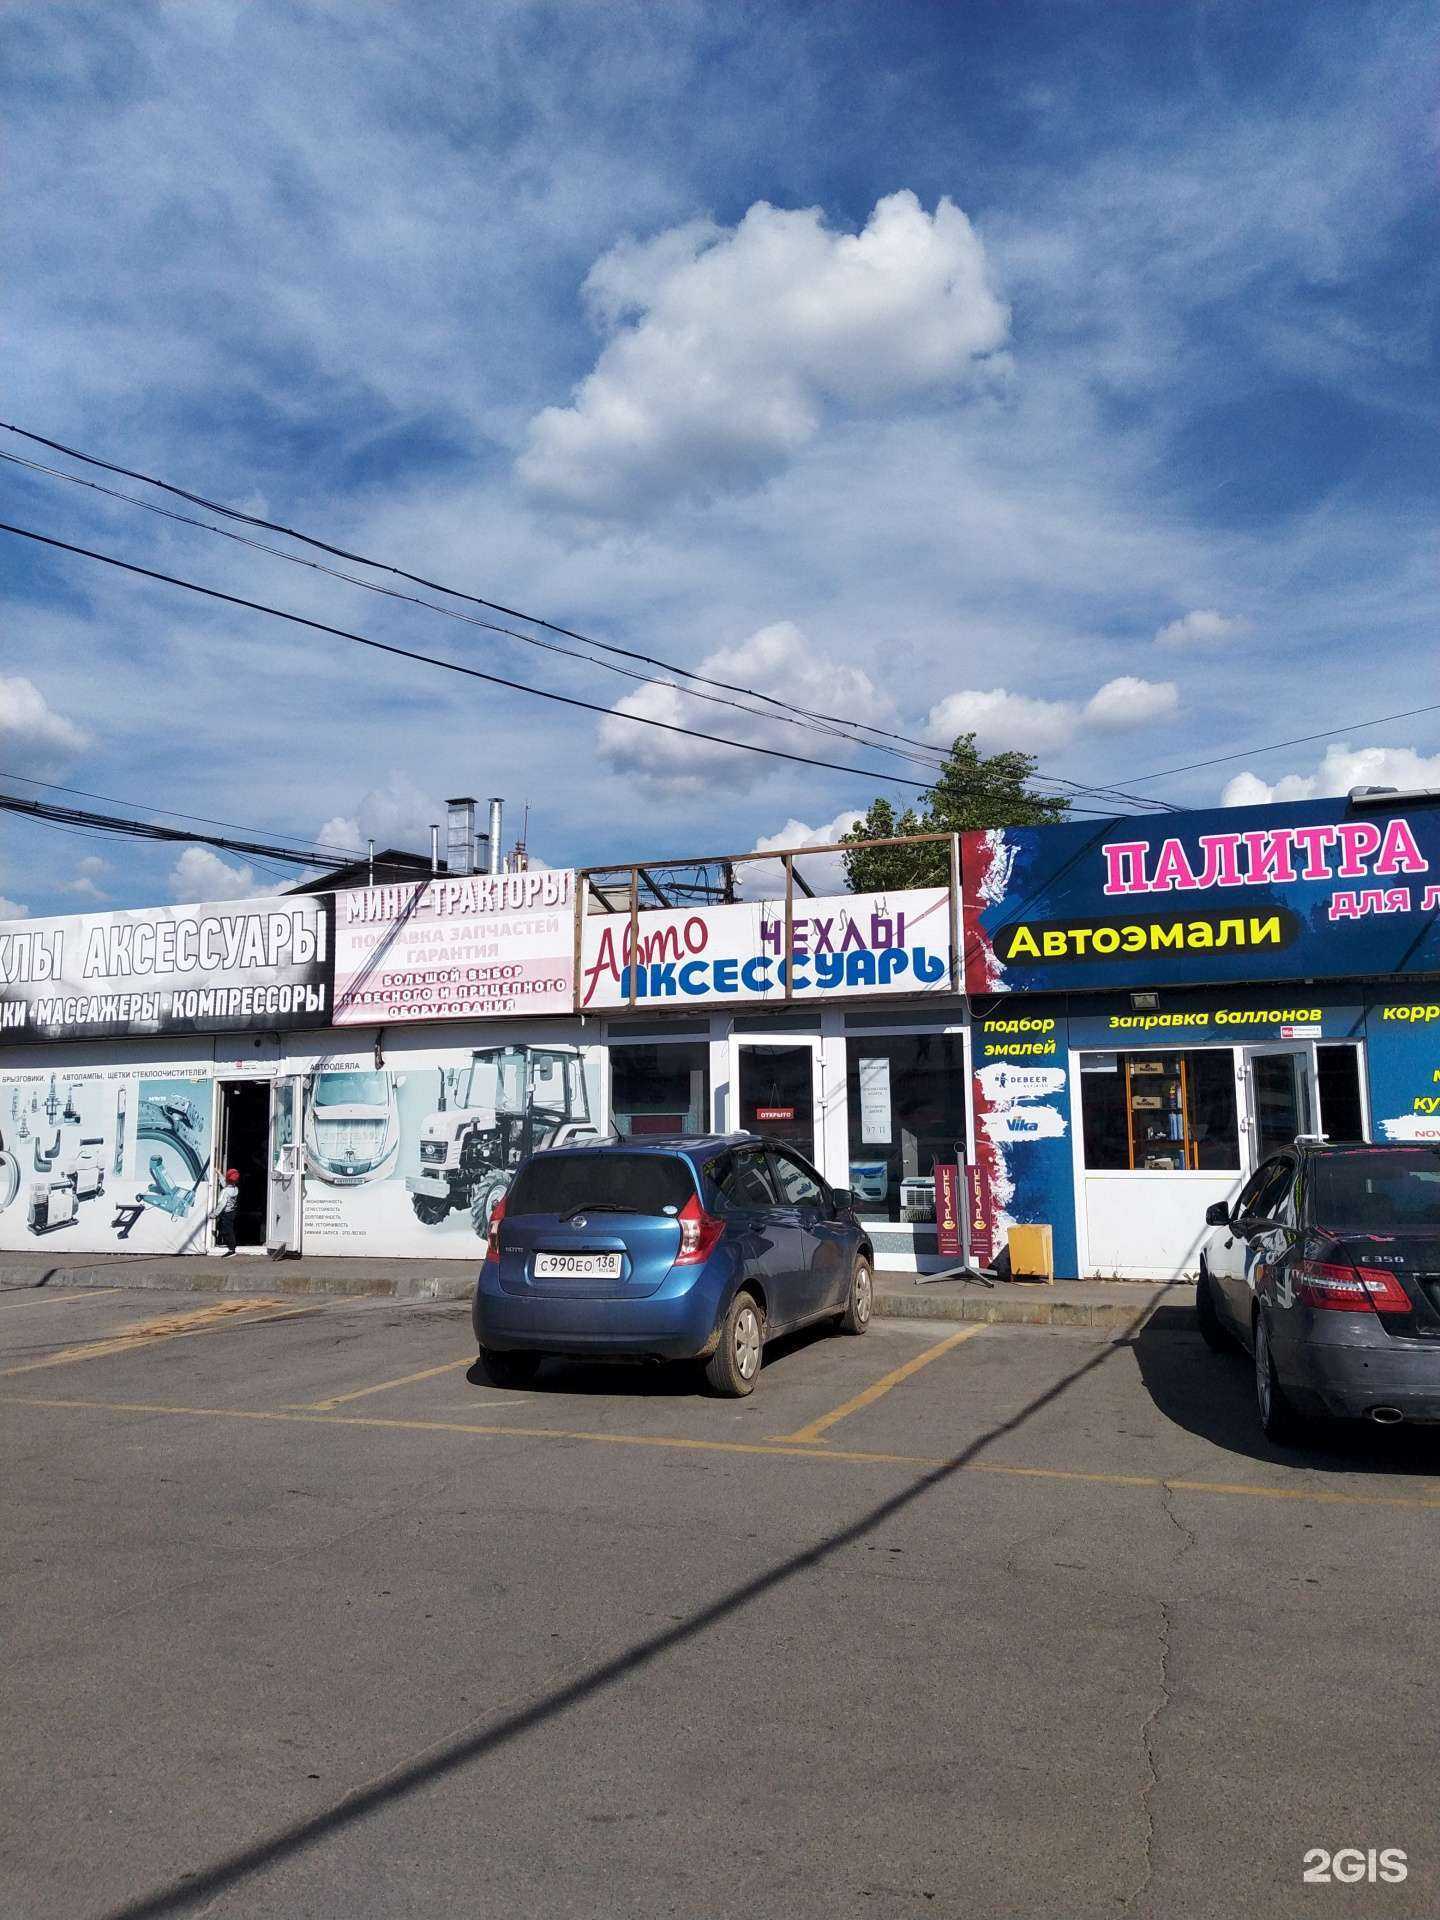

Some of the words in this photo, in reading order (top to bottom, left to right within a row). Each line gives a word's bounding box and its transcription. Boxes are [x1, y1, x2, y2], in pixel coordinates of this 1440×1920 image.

[1103, 818, 1428, 896] ПАЛИТРА
[346, 873, 568, 924] МИНИ-ТРАКТОРЫ
[1329, 888, 1411, 921] для
[449, 914, 559, 942] ЗАПЧАСТЕЙ
[761, 912, 905, 955] ЧЕХЛЫ
[1007, 916, 1282, 958] Автоэмали
[83, 910, 327, 979] АКСЕССУАРЫ
[407, 943, 499, 963] ГАРАНТИЯ
[382, 967, 461, 986] БОЛЬШОЙ
[467, 965, 523, 981] ВЫБОР
[439, 987, 450, 999] И
[458, 979, 566, 999] ПРИЦЕПНОГО
[0, 1000, 27, 1030] КИ
[36, 991, 160, 1026] МАССАЖЕРЫ
[171, 983, 326, 1018] КОМПРЕССОРЫ
[388, 999, 515, 1017] ОБОРУДОВАНИЯ
[1383, 1005, 1440, 1022] корр
[984, 1017, 1055, 1034] подбор
[1108, 1011, 1208, 1029] заправка
[1215, 1008, 1322, 1024] баллонов
[984, 1039, 1056, 1056] эмалей
[310, 1062, 360, 1071] АВТООДЕЯЛА
[1006, 1117, 1039, 1131] Vika
[541, 1257, 592, 1272] С990ЕО
[595, 1256, 615, 1268] 138
[1361, 1255, 1370, 1263] E
